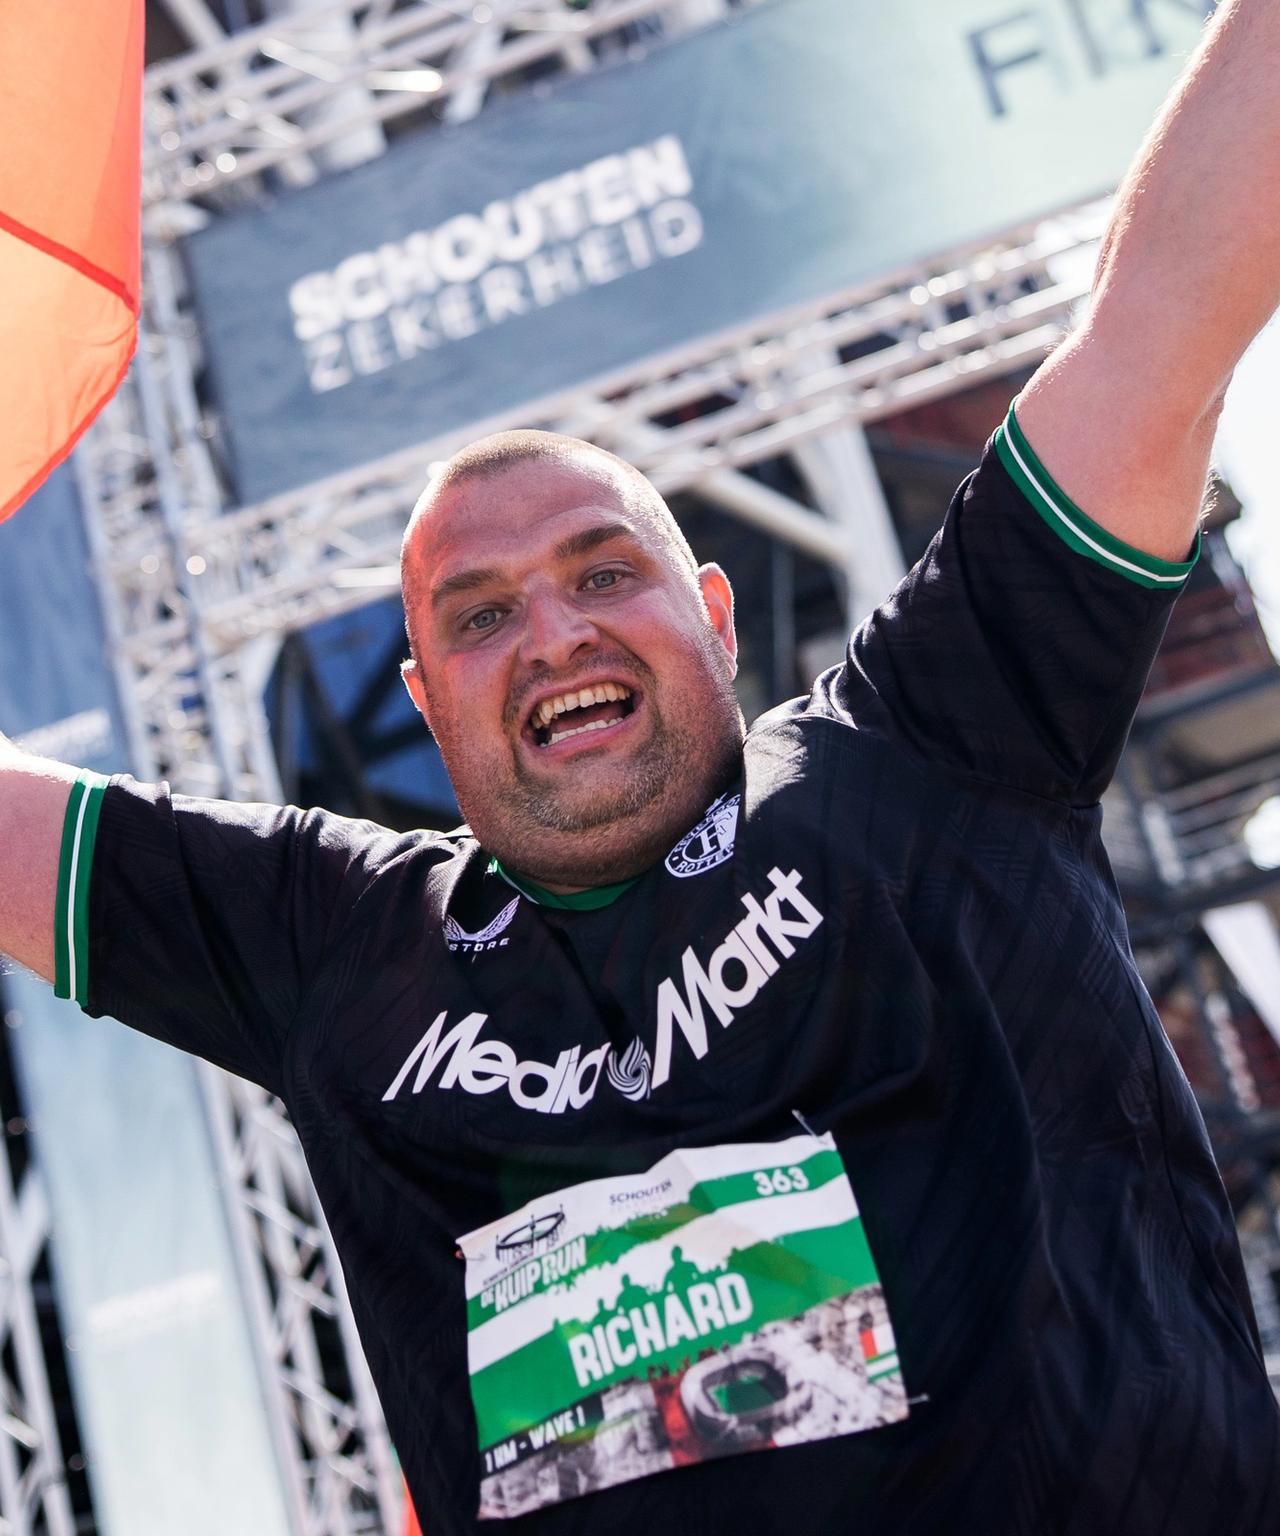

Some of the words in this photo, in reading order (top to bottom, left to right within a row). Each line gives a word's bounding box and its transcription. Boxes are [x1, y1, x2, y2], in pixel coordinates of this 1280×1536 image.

[289, 135, 694, 341] SCHOUTEN
[304, 198, 704, 393] ZEKERHEID
[448, 937, 511, 953] STORE
[753, 1166, 810, 1197] 363
[567, 1272, 756, 1389] RICHARD
[527, 1409, 577, 1451] WAVE
[576, 1404, 586, 1428] 1
